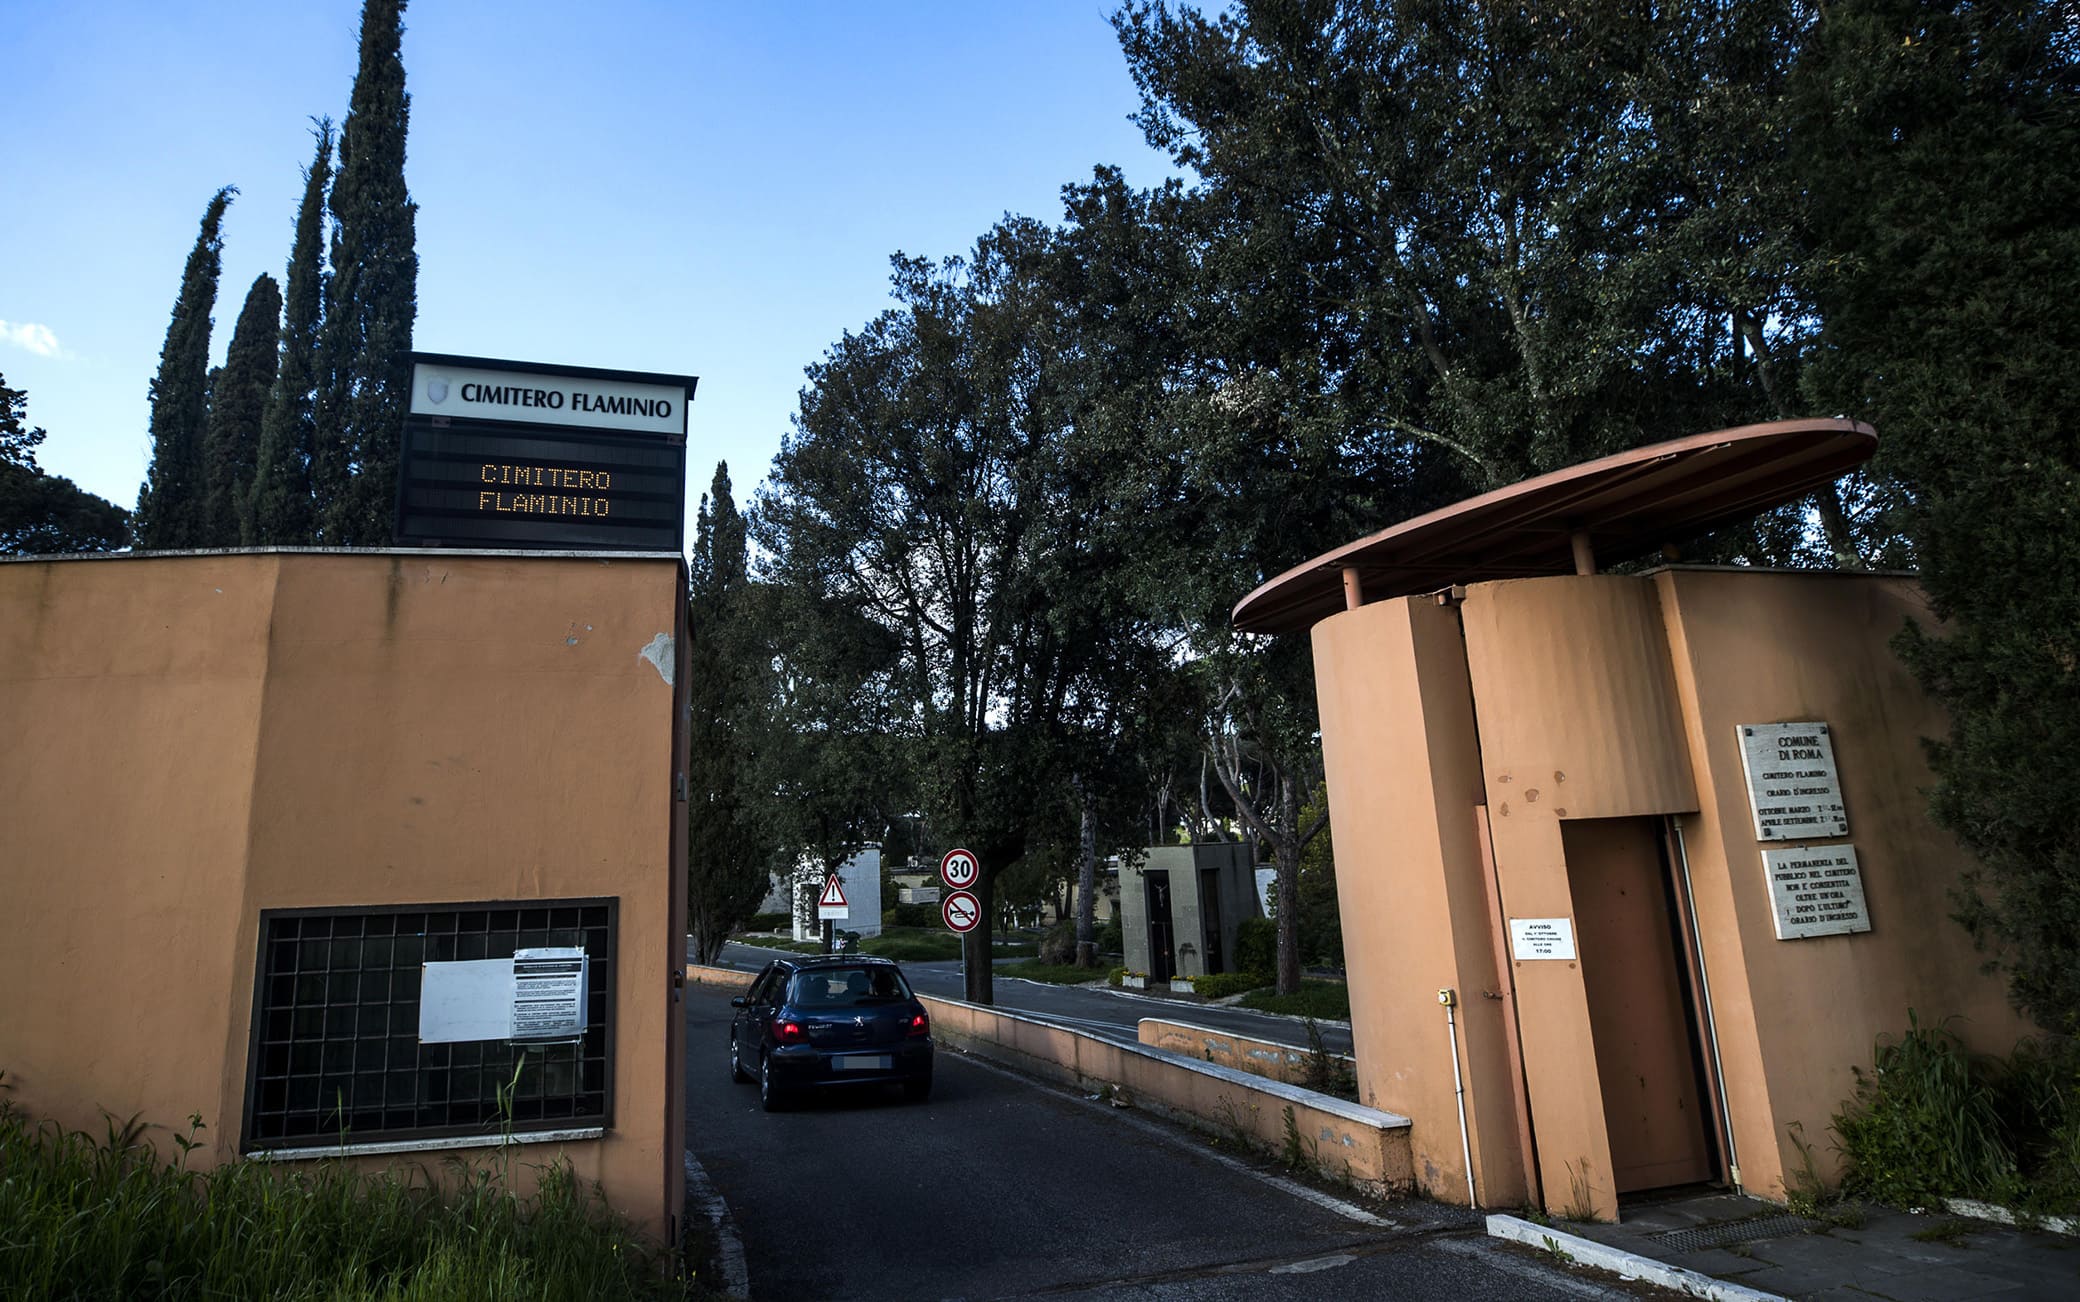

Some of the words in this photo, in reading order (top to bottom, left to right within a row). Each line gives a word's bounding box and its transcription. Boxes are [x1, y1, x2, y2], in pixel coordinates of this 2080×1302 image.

[460, 383, 564, 409] CIMITERO
[571, 392, 672, 418] FLAMINIO
[481, 464, 611, 490] CIMITERO
[479, 491, 610, 517] FLAMINIO
[1778, 736, 1820, 748] COMUNE
[1778, 750, 1790, 761] DI
[1793, 749, 1824, 760] ROMA
[1762, 772, 1794, 780] CIMITERO
[1795, 770, 1828, 778] FLAMINIO
[1766, 789, 1792, 797] ORARIO
[1793, 787, 1830, 796] D'INGRESSO
[1758, 807, 1788, 815] OTTOBRE
[1789, 806, 1811, 814] MARZO
[1783, 817, 1818, 825] SETTEMBRE
[950, 860, 971, 878] 30
[1777, 862, 1788, 870] LA
[1790, 859, 1833, 869] PERMANENZA
[1835, 857, 1849, 866] DEL
[1774, 872, 1807, 881] PUBBLICO
[1809, 871, 1822, 879] NEL
[1824, 869, 1857, 877] CIMITERO
[1785, 883, 1800, 891] NON
[1810, 880, 1850, 890] CONSENTITA
[1795, 893, 1818, 902] OLTRE
[1819, 891, 1844, 900] UN'ORA
[1795, 904, 1816, 913] DOPO
[1817, 901, 1849, 911] L'ULTIMO
[1790, 915, 1818, 924] ORARIO
[1819, 912, 1858, 922] D'INGRESSO
